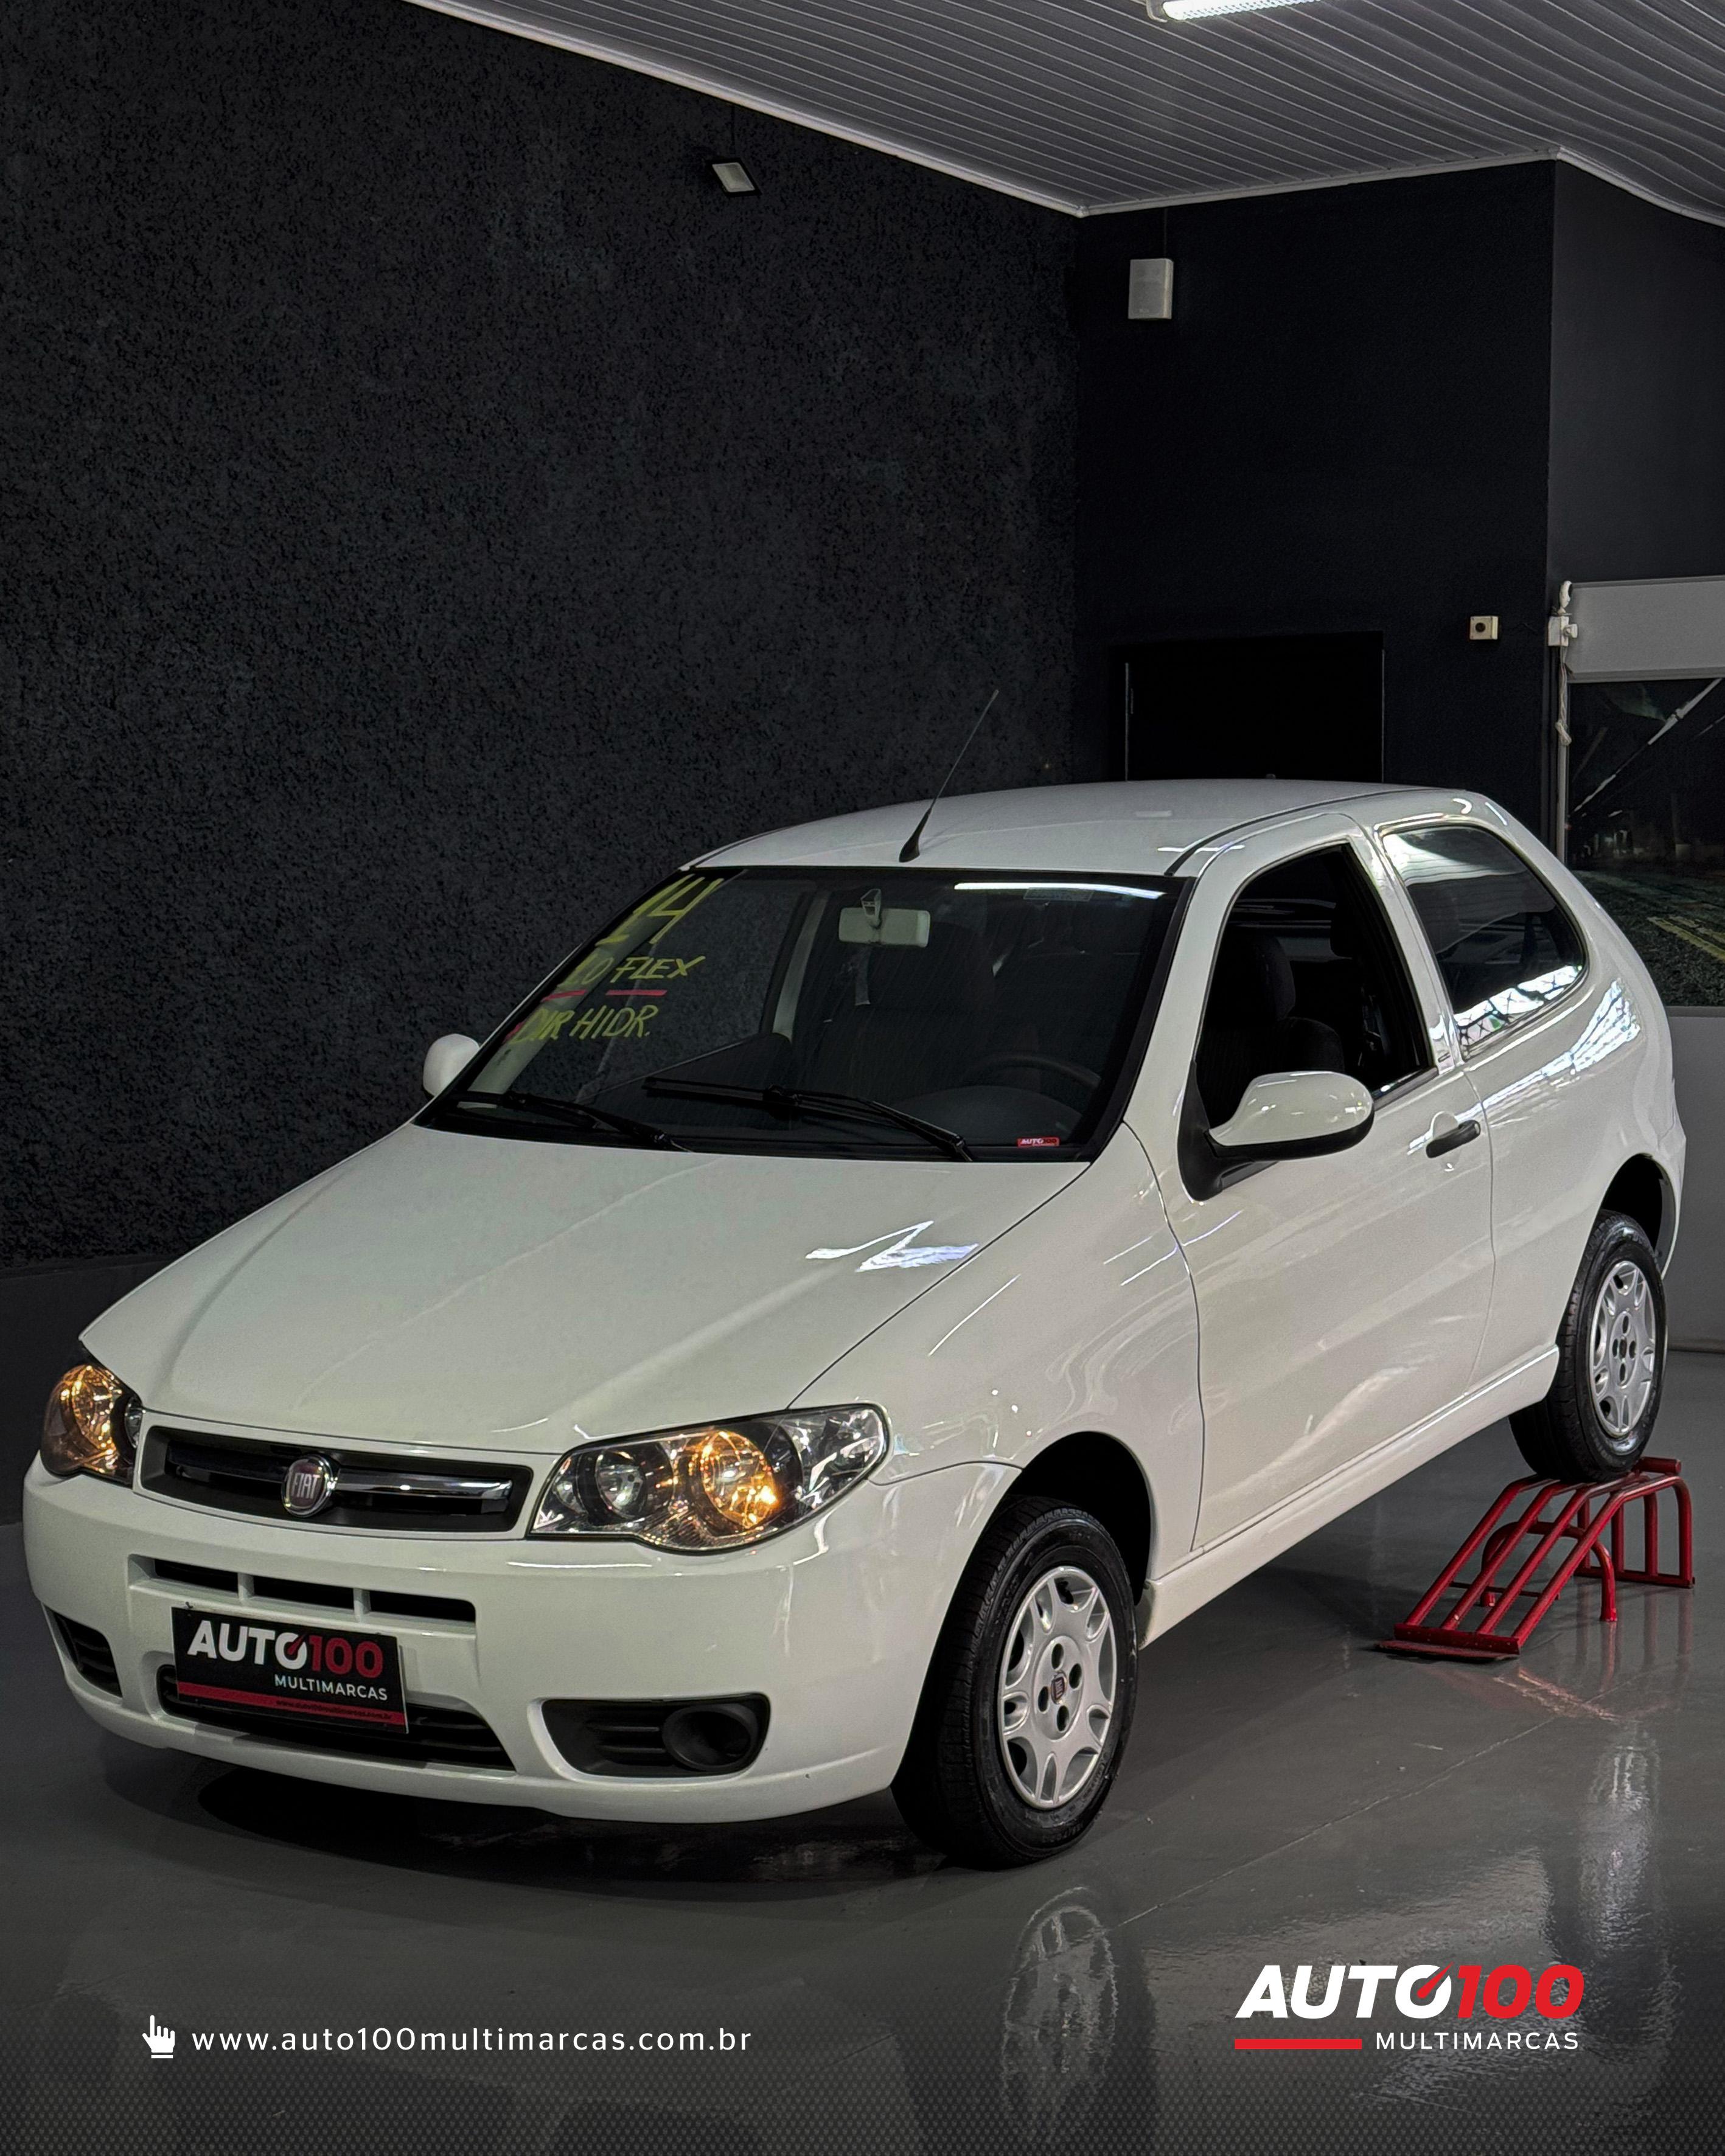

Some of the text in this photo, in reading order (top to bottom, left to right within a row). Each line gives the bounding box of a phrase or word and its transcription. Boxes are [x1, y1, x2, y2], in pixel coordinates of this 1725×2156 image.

[610, 955, 706, 983] FLEX
[291, 1472, 321, 1499] FIAT
[187, 1619, 383, 1679] AUTO100
[274, 1674, 388, 1701] MULTIMARCAS
